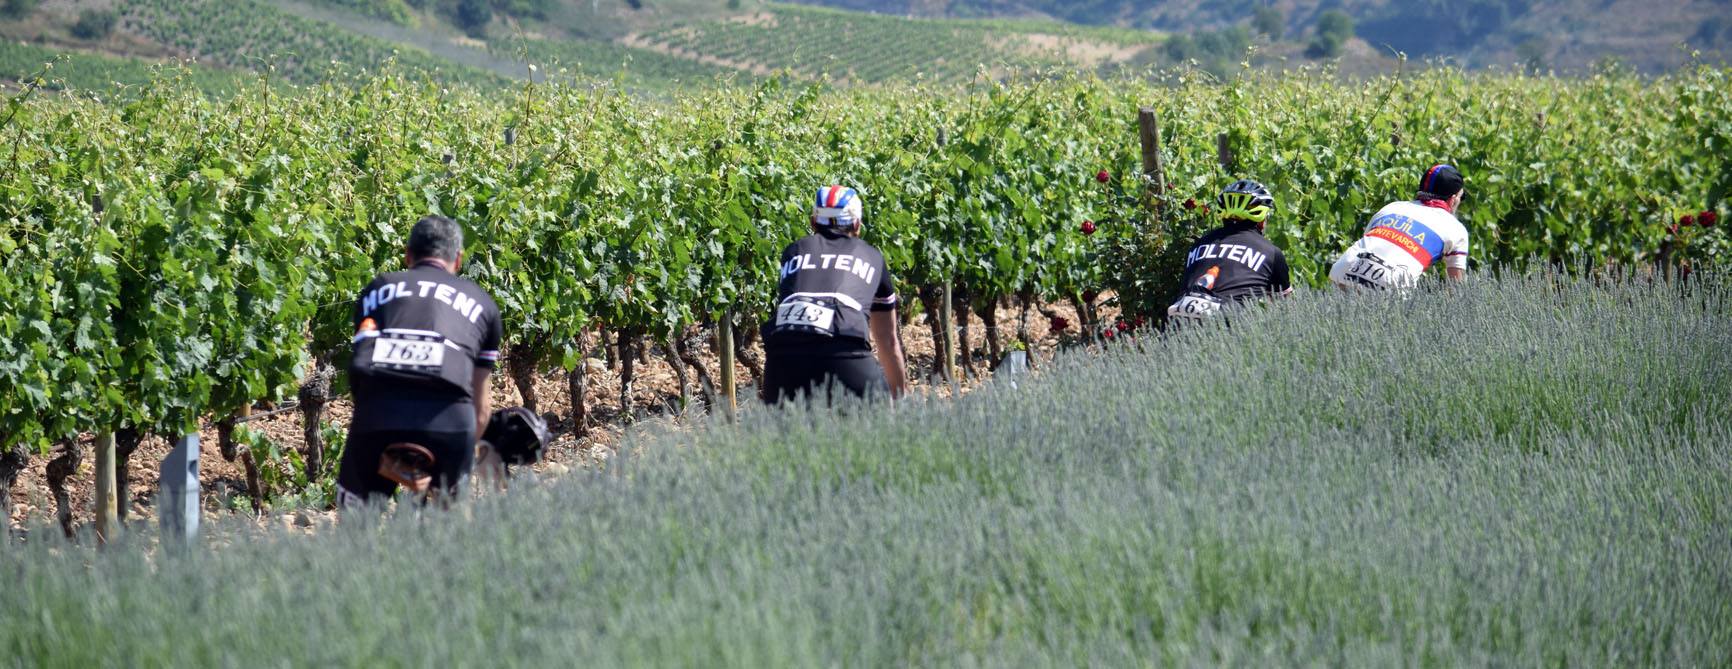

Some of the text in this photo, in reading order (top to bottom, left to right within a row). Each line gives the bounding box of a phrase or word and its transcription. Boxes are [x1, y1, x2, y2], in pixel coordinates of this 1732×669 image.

[1373, 227, 1419, 253] ONTEVARCHI
[780, 254, 875, 284] MOLTENI
[1187, 244, 1266, 271] MOLTENI
[1351, 259, 1385, 280] 310
[362, 280, 484, 323] MOLTENI
[781, 304, 823, 322] 443
[384, 342, 433, 361] 163
